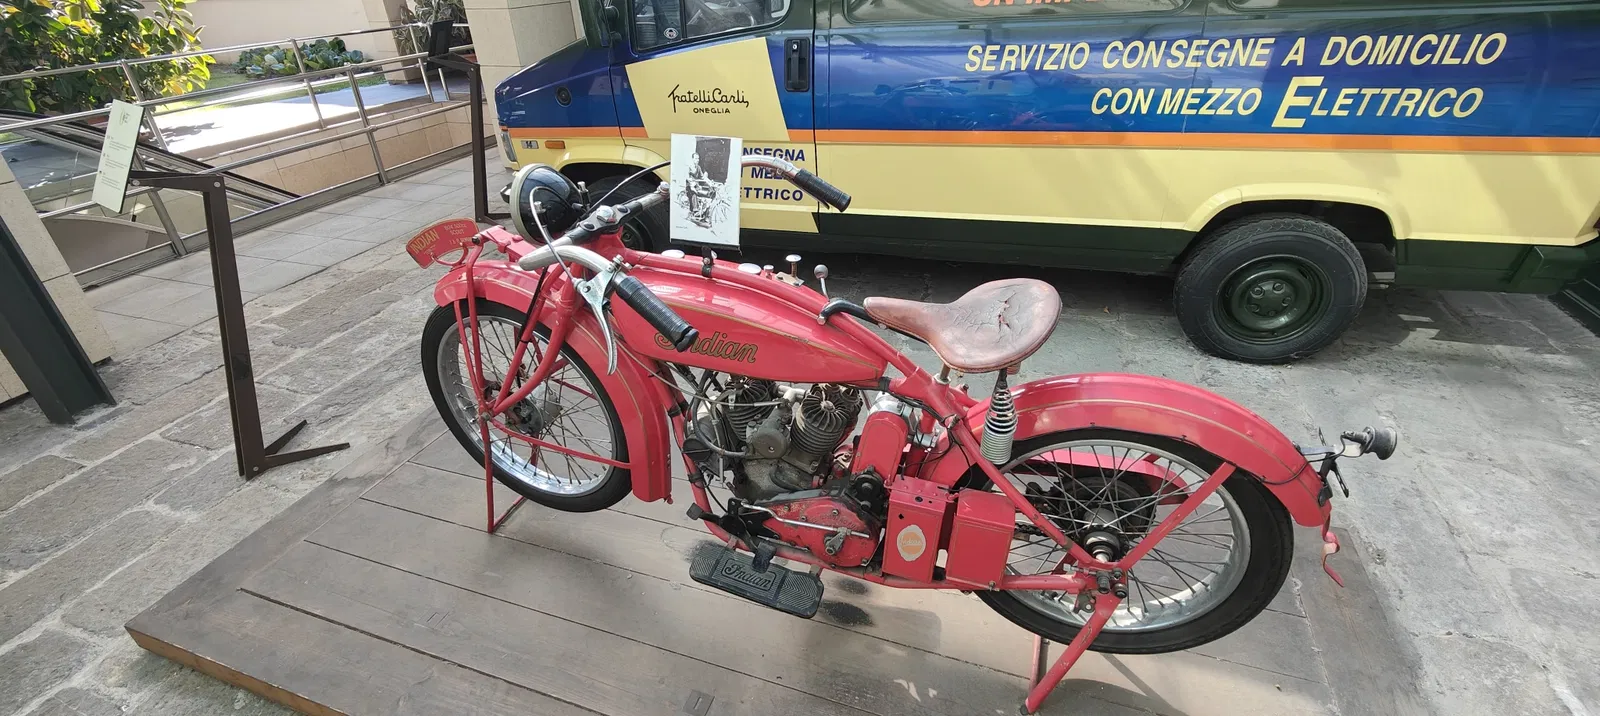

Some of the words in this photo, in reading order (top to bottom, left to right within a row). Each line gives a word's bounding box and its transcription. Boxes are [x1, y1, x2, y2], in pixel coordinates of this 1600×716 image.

[965, 42, 1090, 72] SERVIZIO
[1102, 38, 1275, 69] CONSEGNE
[1282, 37, 1305, 66] A
[1320, 32, 1507, 66] DOMICILIO
[1091, 87, 1155, 115] CON
[1156, 87, 1263, 115] MEZZO
[1271, 76, 1483, 128] ELETTRICO
[743, 147, 805, 162] NSEGNA
[740, 187, 803, 201] TTRICO
[410, 229, 440, 254] INDIAN
[724, 563, 771, 588] Indian
